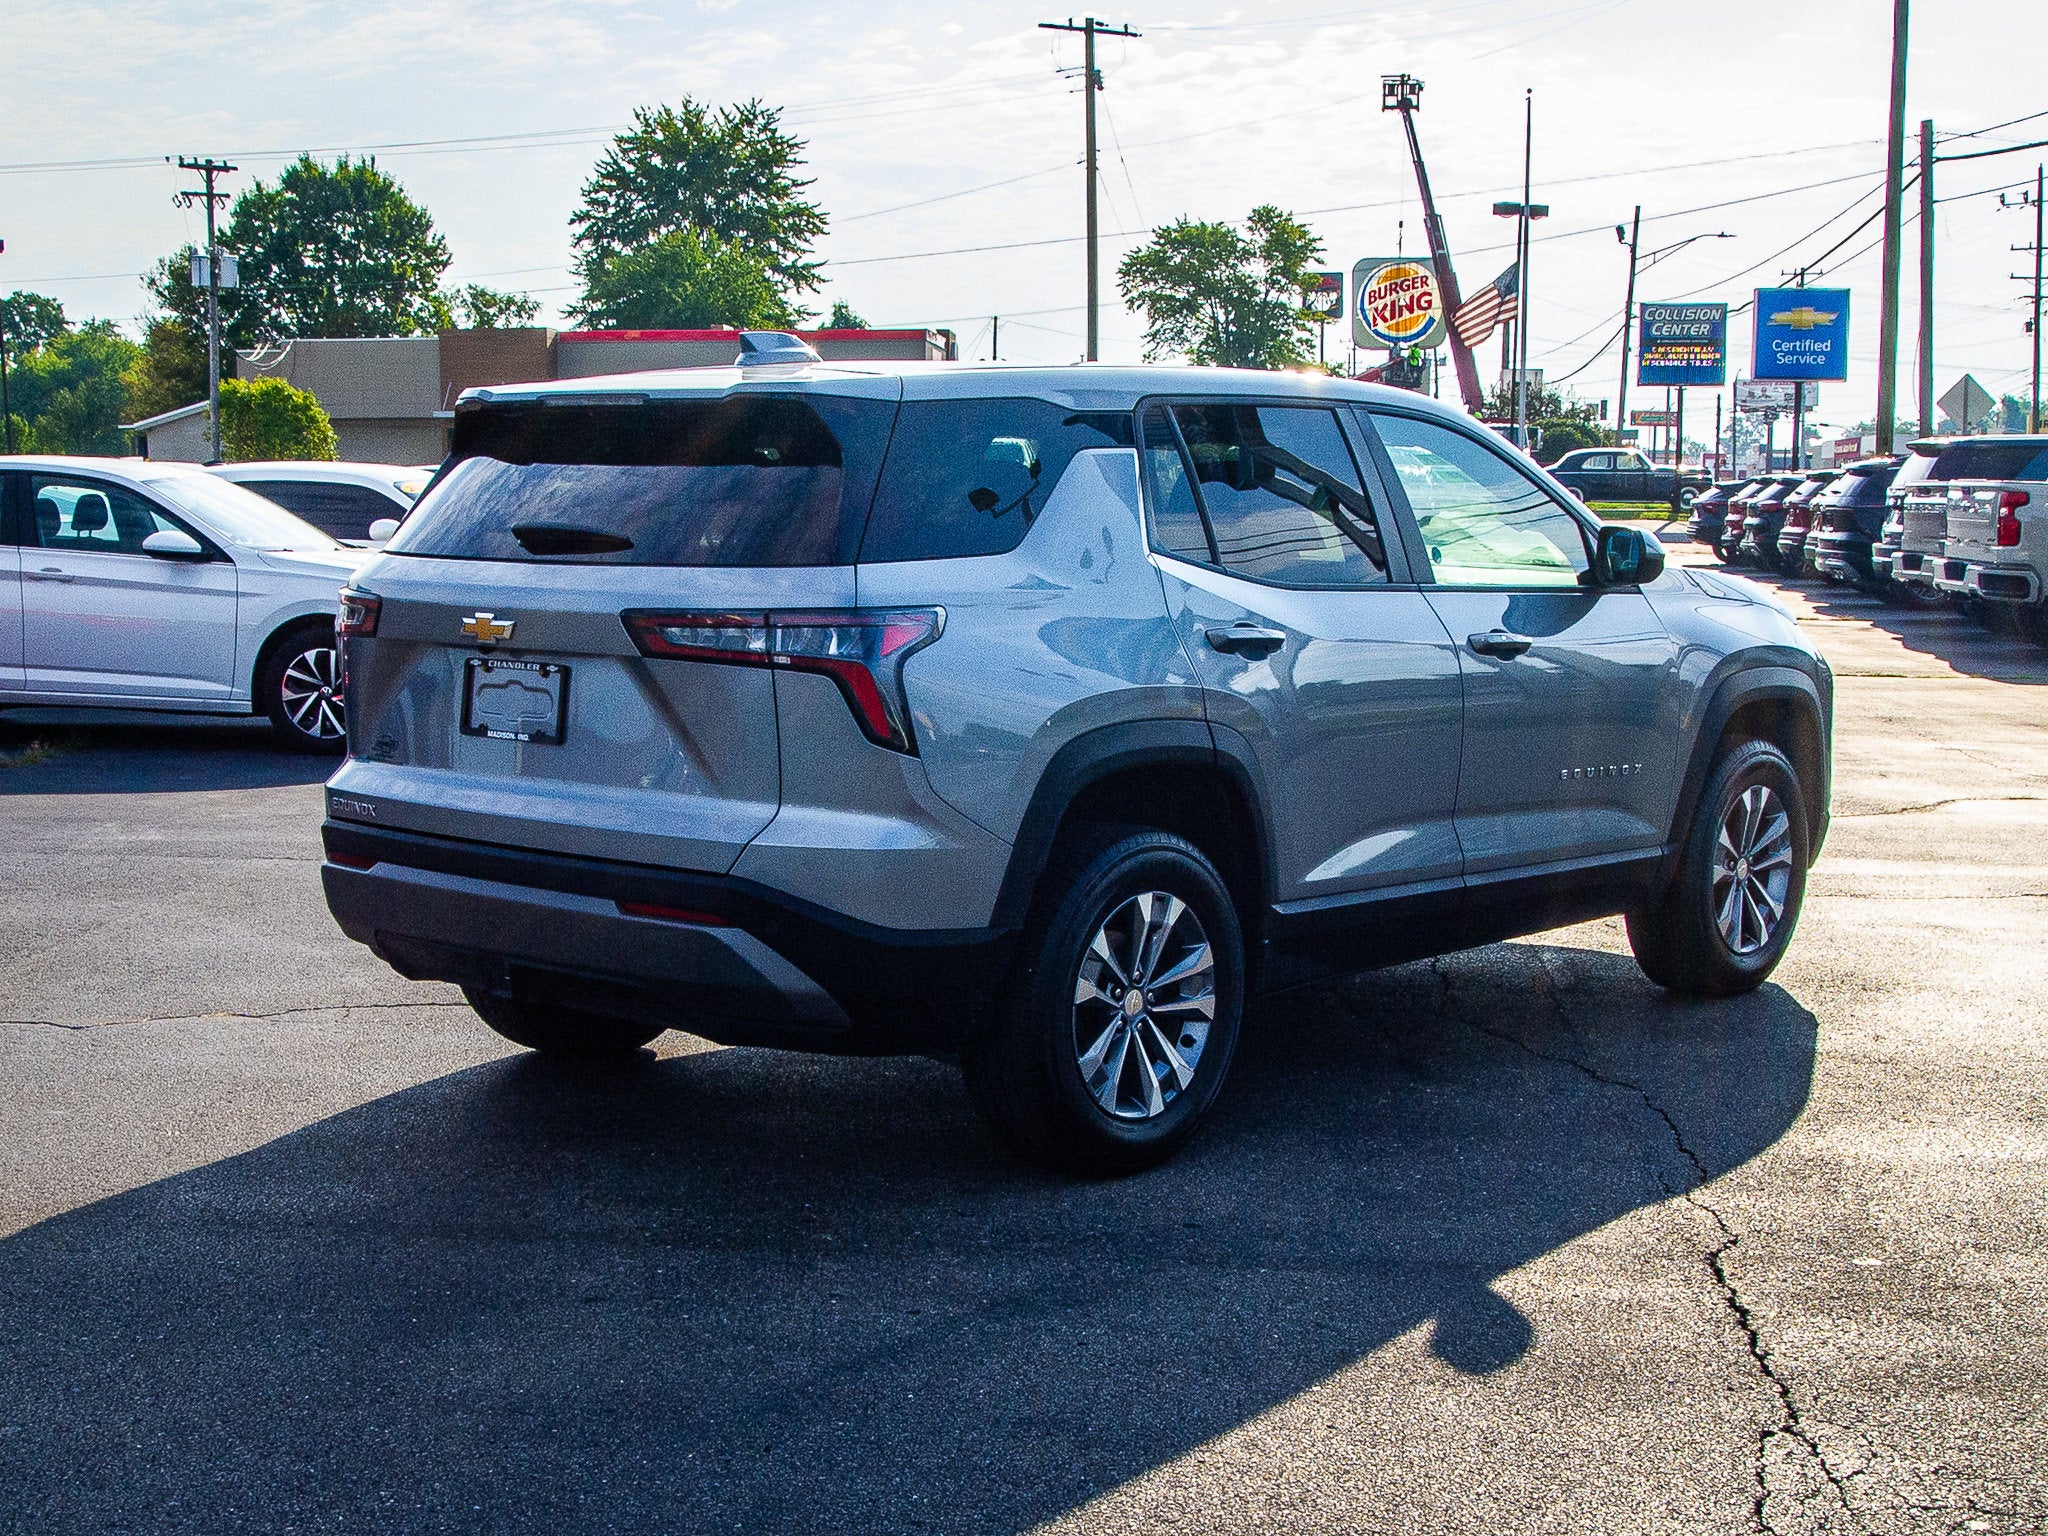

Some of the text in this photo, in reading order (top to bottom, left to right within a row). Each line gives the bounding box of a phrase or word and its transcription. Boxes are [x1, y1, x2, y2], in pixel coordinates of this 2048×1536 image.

[1368, 275, 1430, 306] BURGER
[1371, 291, 1433, 328] KING
[1644, 307, 1722, 321] COLLISION
[1651, 322, 1711, 336] CENTER
[1772, 339, 1832, 352] Certified
[1776, 352, 1826, 365] Service
[488, 660, 540, 671] CHANDLER
[1561, 763, 1643, 780] EQUINOX
[332, 797, 376, 817] EQUINOX
